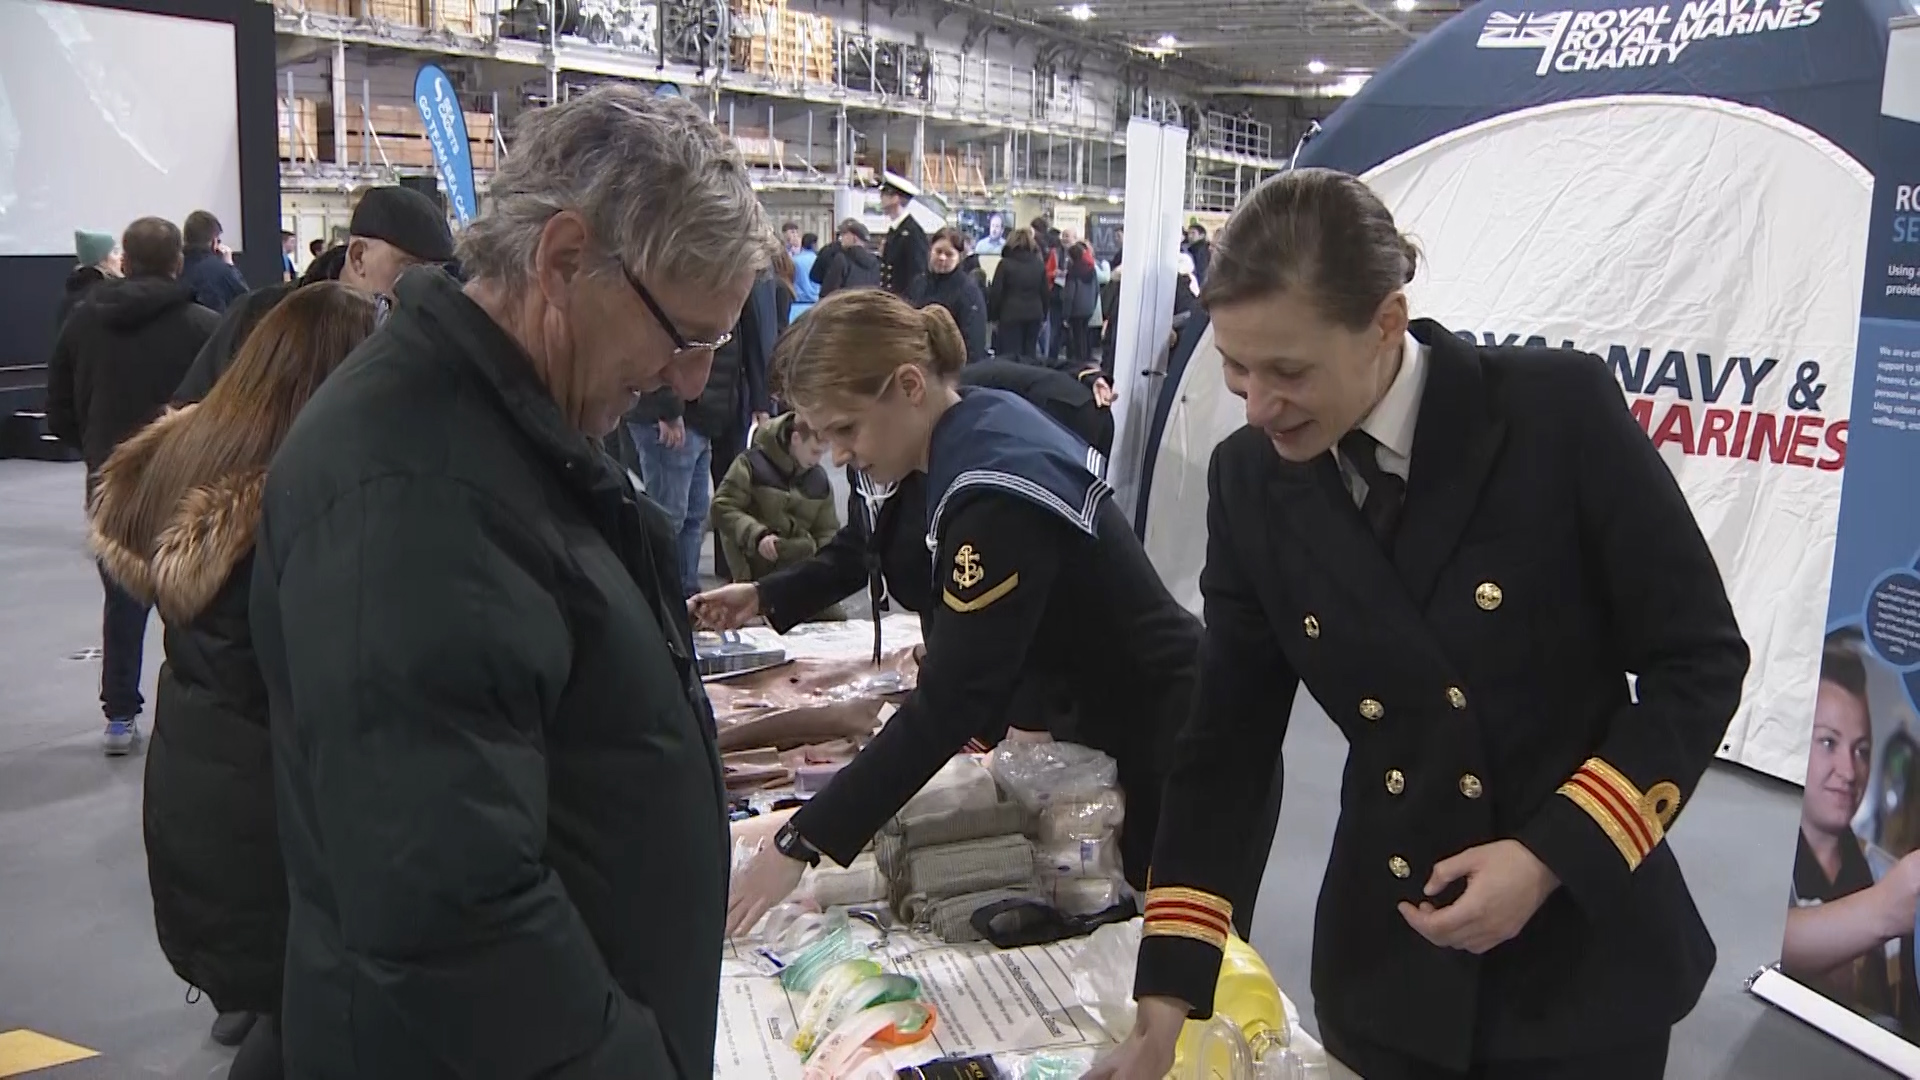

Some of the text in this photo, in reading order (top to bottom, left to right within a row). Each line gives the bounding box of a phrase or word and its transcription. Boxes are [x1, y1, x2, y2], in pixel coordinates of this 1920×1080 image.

[1562, 1, 1823, 51] ROYAL MARINES
[1571, 0, 1767, 30] ROYAL NAVY
[1555, 42, 1688, 73] CHARITY
[428, 119, 448, 165] TEAM
[1888, 264, 1915, 280] Using
[1608, 345, 1827, 412] NAVY &
